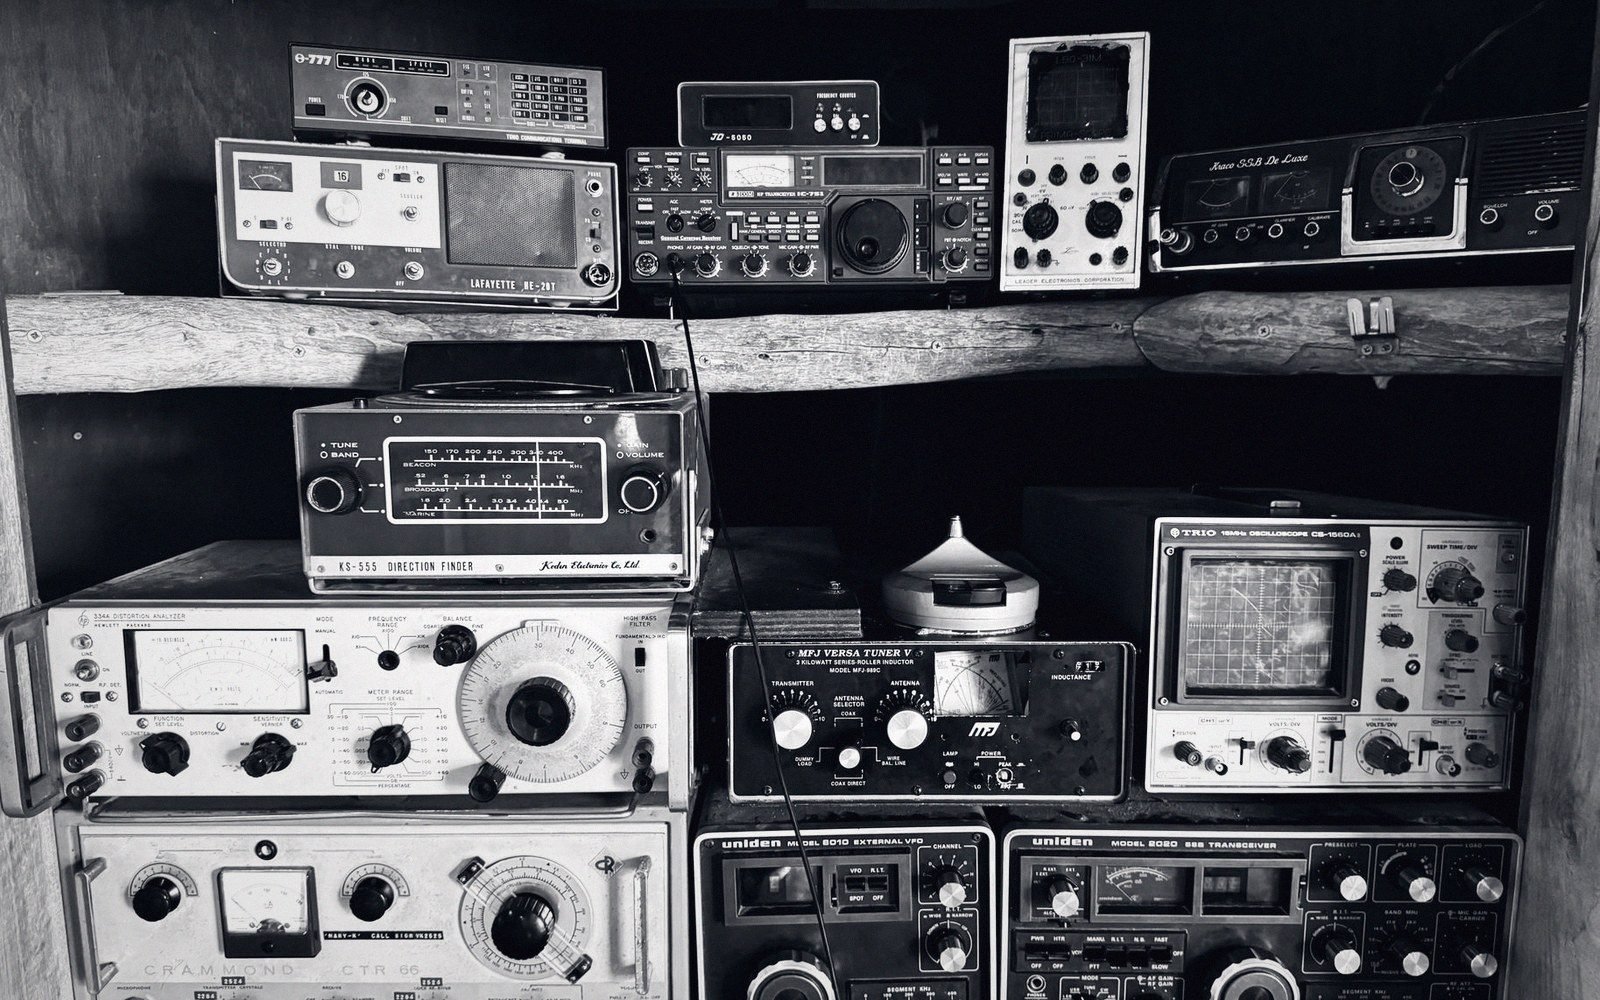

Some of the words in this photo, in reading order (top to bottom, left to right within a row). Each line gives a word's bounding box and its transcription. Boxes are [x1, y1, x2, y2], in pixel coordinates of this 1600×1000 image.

[1237, 157, 1263, 168] SSB
[1264, 155, 1279, 166] De
[1281, 153, 1309, 163] Luxe
[336, 171, 347, 182] 16
[470, 279, 516, 290] LAFAYETTE
[1182, 529, 1216, 537] TRIO
[339, 561, 377, 571] KS-555
[388, 561, 435, 571] DIRECTION
[441, 561, 474, 571] FINDER
[798, 649, 822, 657] MFJ
[824, 649, 860, 657] VERSA
[863, 649, 901, 657] TUNER
[968, 722, 1001, 736] MFJ
[722, 839, 781, 849] uniden
[853, 838, 903, 846] EXTERNAL
[1032, 837, 1093, 846] uniden
[1111, 840, 1145, 848] MODEL
[1148, 840, 1178, 848] 2020
[1208, 841, 1277, 849] TRANSCEIVER
[144, 964, 294, 976] CRAMMOND
[400, 965, 419, 976] 66
